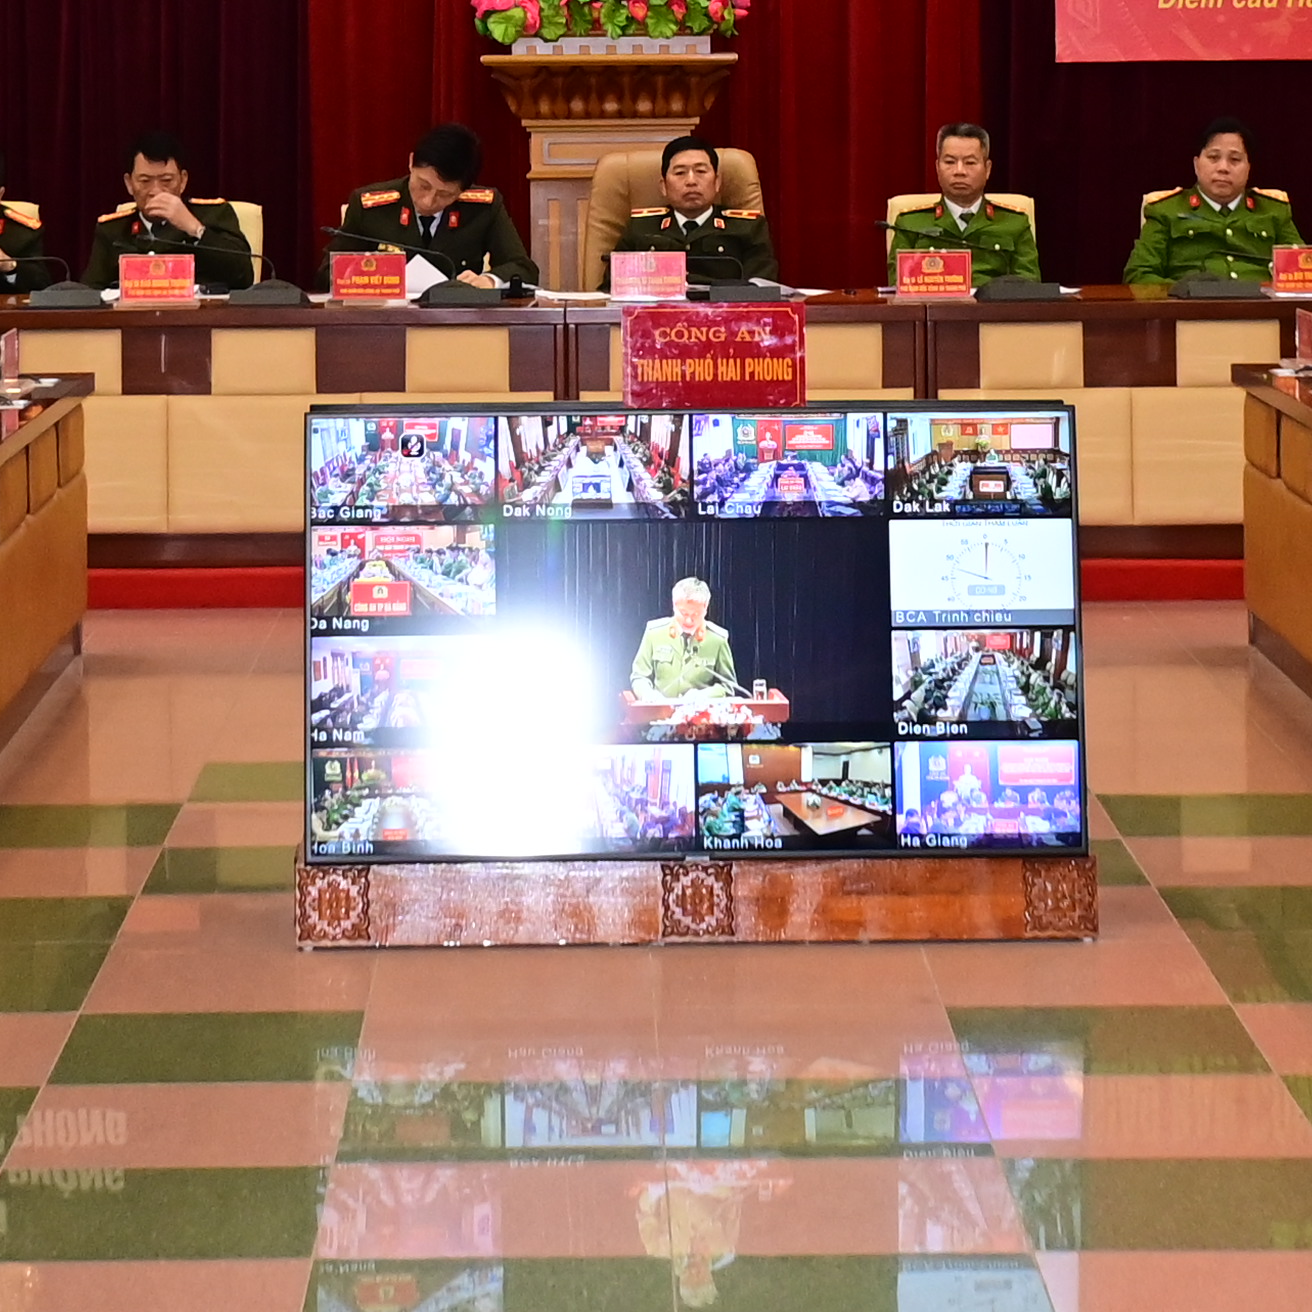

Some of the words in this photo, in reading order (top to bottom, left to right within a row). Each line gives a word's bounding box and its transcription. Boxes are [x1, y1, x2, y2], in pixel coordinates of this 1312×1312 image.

[655, 322, 726, 343] CÔNG
[735, 326, 773, 342] AN
[638, 355, 681, 382] THÀNH
[686, 350, 713, 381] PHỐ
[718, 349, 740, 381] HẢI
[745, 353, 792, 381] PHÒNG
[503, 505, 530, 517] Dak
[536, 506, 572, 518] Nong
[698, 503, 718, 516] Lai
[725, 503, 761, 515] Chau
[893, 500, 920, 513] Dak
[926, 500, 950, 513] Lak
[340, 507, 381, 520] Giang
[896, 612, 926, 623] BCA
[933, 612, 968, 623] Trinh
[974, 611, 1011, 622] chieu
[333, 618, 369, 630] Nang
[898, 721, 930, 735] Dien
[936, 721, 968, 736] Bien
[333, 729, 364, 742] Nam
[704, 837, 748, 849] Khanh
[755, 837, 782, 849] Hoa
[901, 834, 920, 847] Ha
[926, 834, 967, 848] Giang
